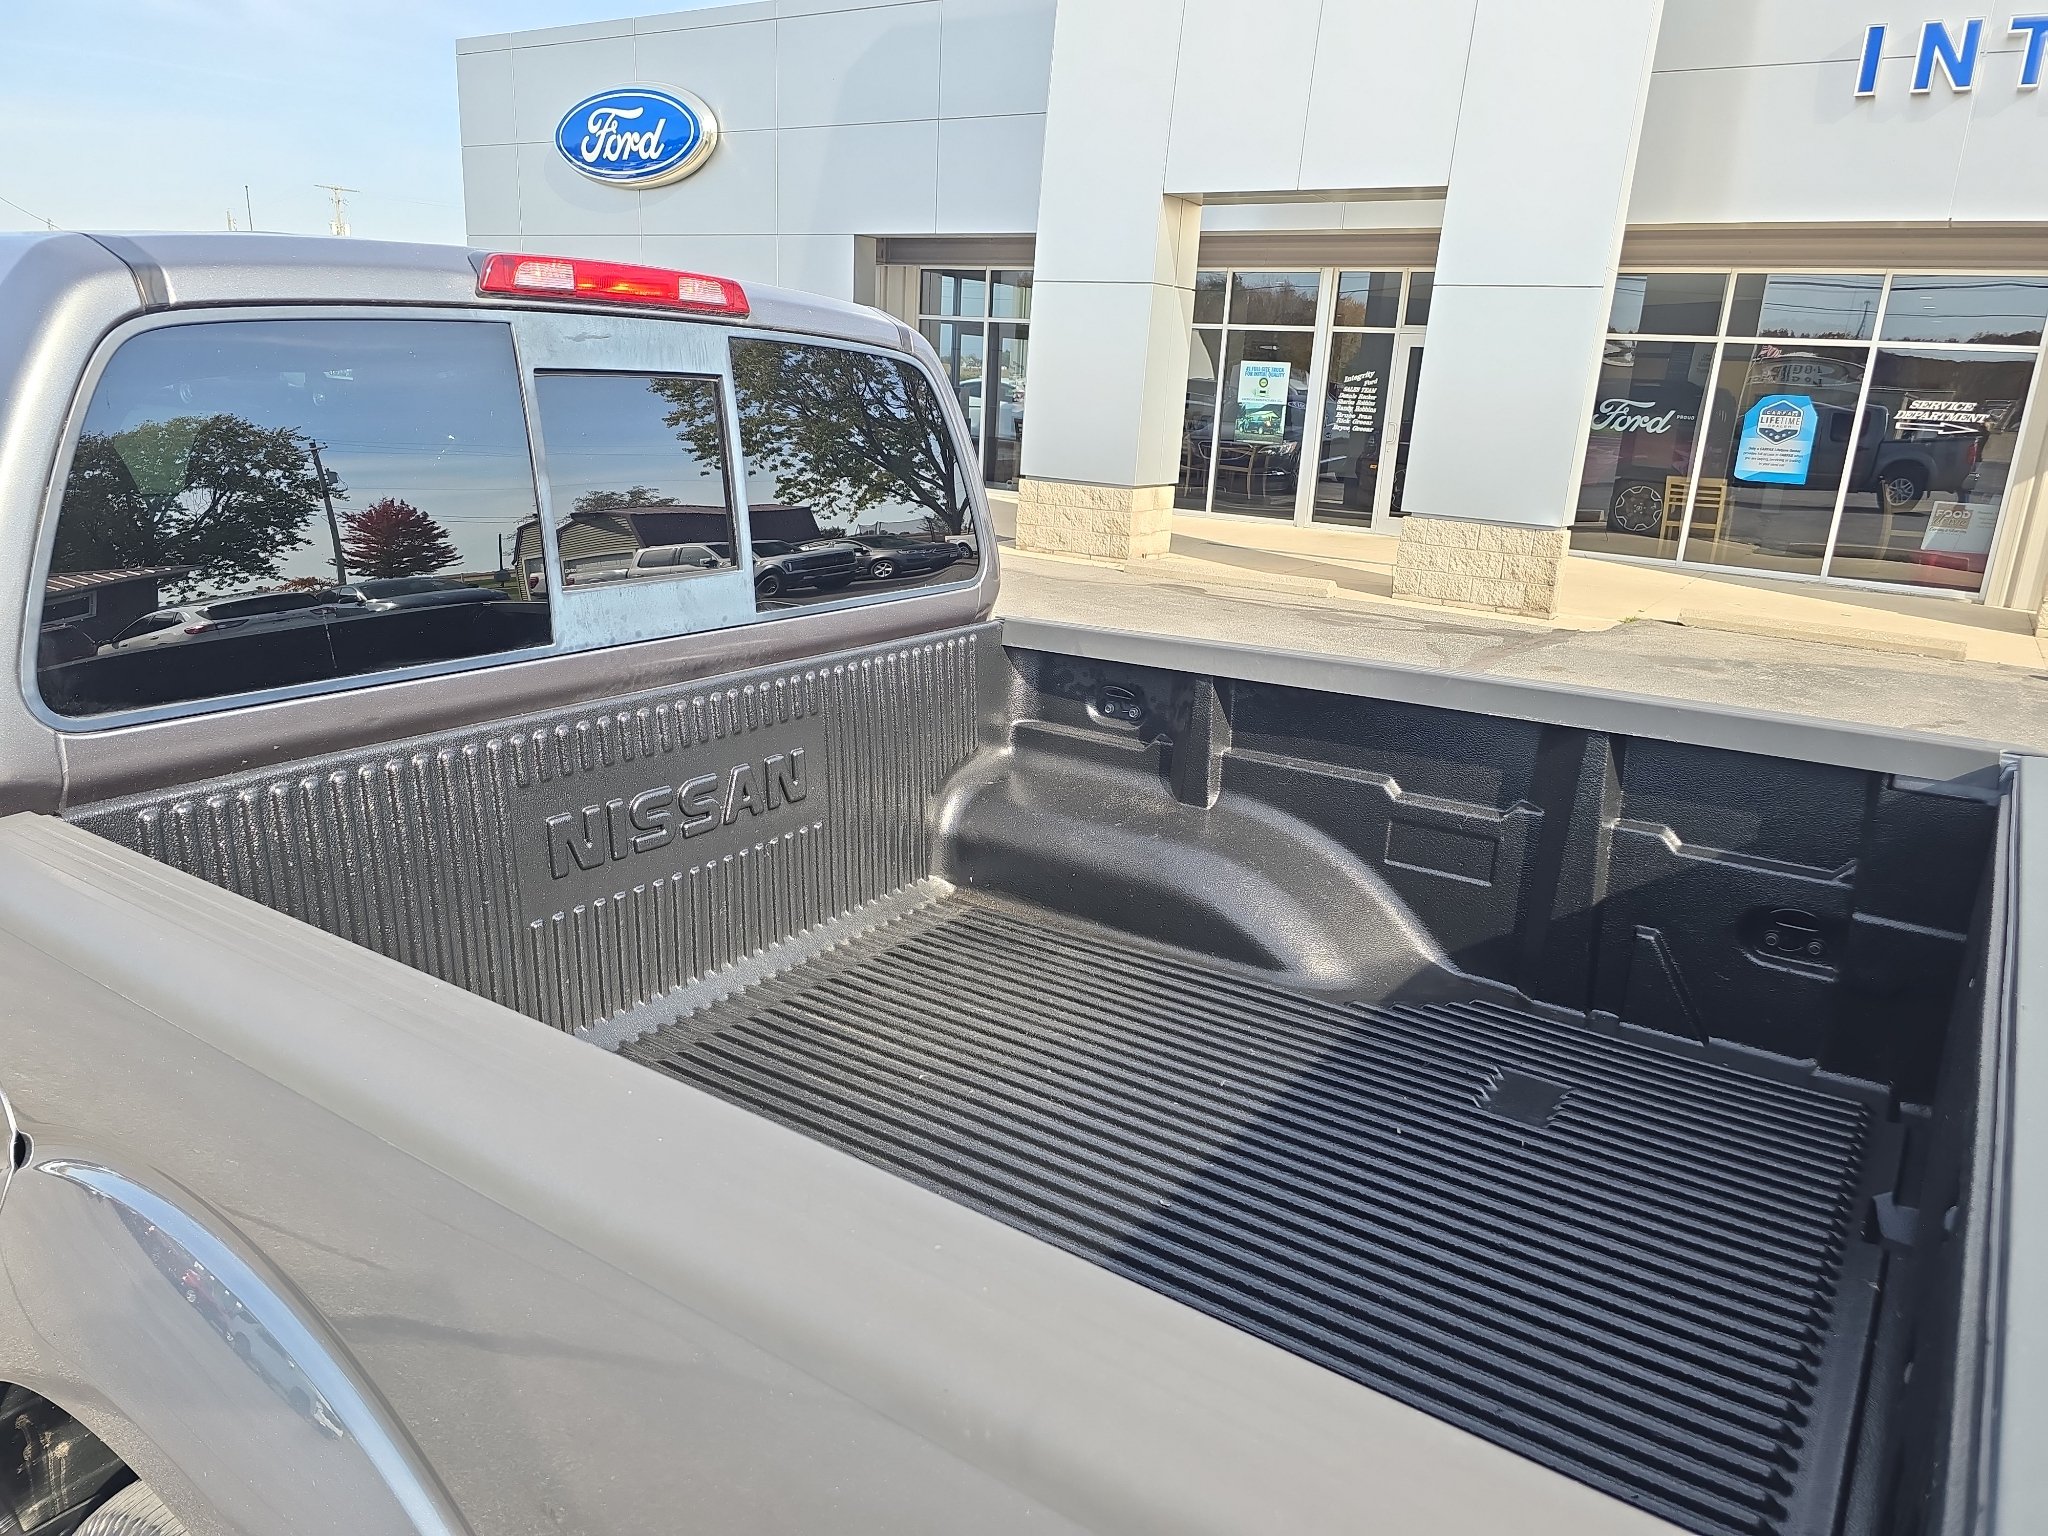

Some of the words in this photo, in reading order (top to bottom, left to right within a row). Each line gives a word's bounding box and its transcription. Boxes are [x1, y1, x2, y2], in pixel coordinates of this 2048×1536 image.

[1853, 13, 2048, 97] INT
[580, 106, 667, 163] Ford
[1343, 370, 1376, 383] Integrity
[1363, 377, 1379, 387] Ford
[1908, 400, 1978, 412] SERVICE
[1590, 398, 1677, 434] Ford
[1760, 416, 1801, 426] LIFETIME
[1893, 410, 1990, 423] DEPARTMENT
[1935, 509, 1971, 519] FOOD
[546, 747, 807, 880] NISSAN
